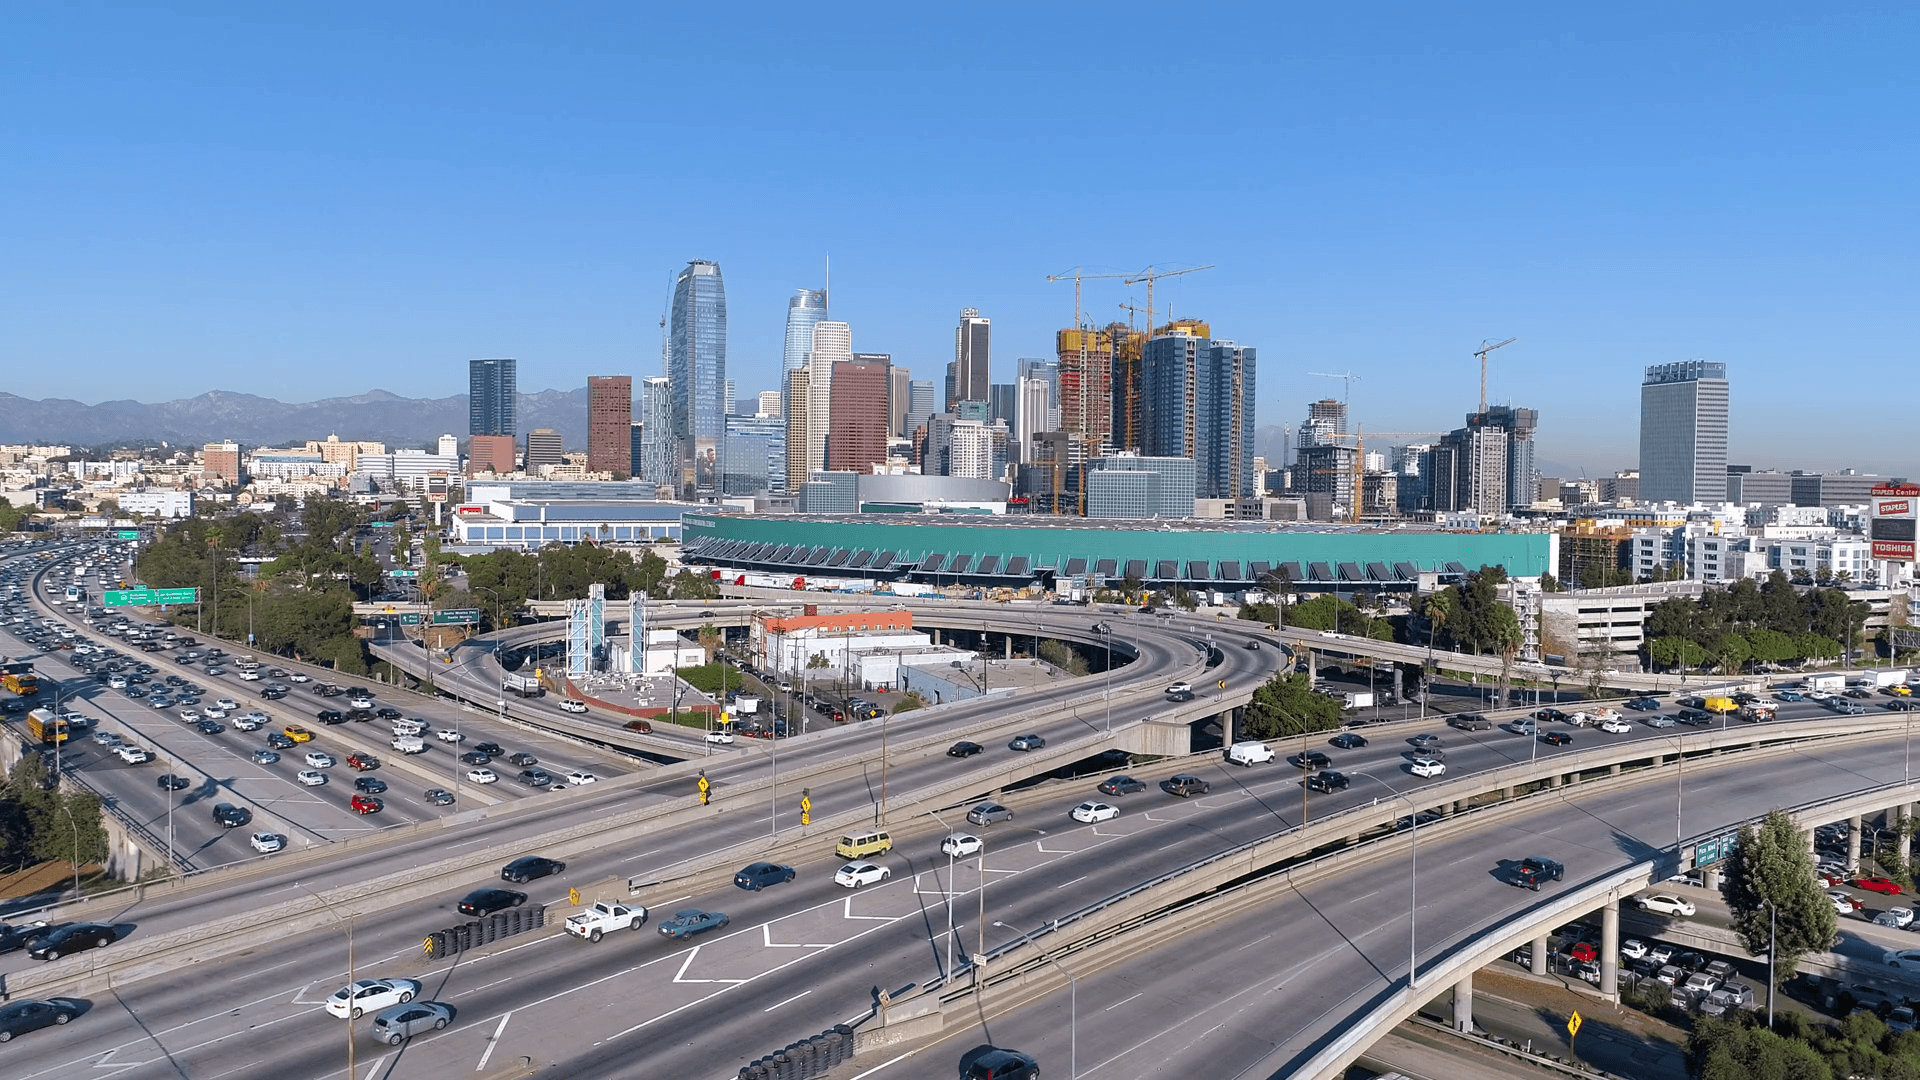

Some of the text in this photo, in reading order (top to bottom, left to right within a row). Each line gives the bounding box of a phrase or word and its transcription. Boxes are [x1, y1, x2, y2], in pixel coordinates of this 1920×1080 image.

[1880, 503, 1908, 512] STAPLES
[1874, 543, 1913, 553] TOSHIBA
[1707, 842, 1716, 851] Blvd
